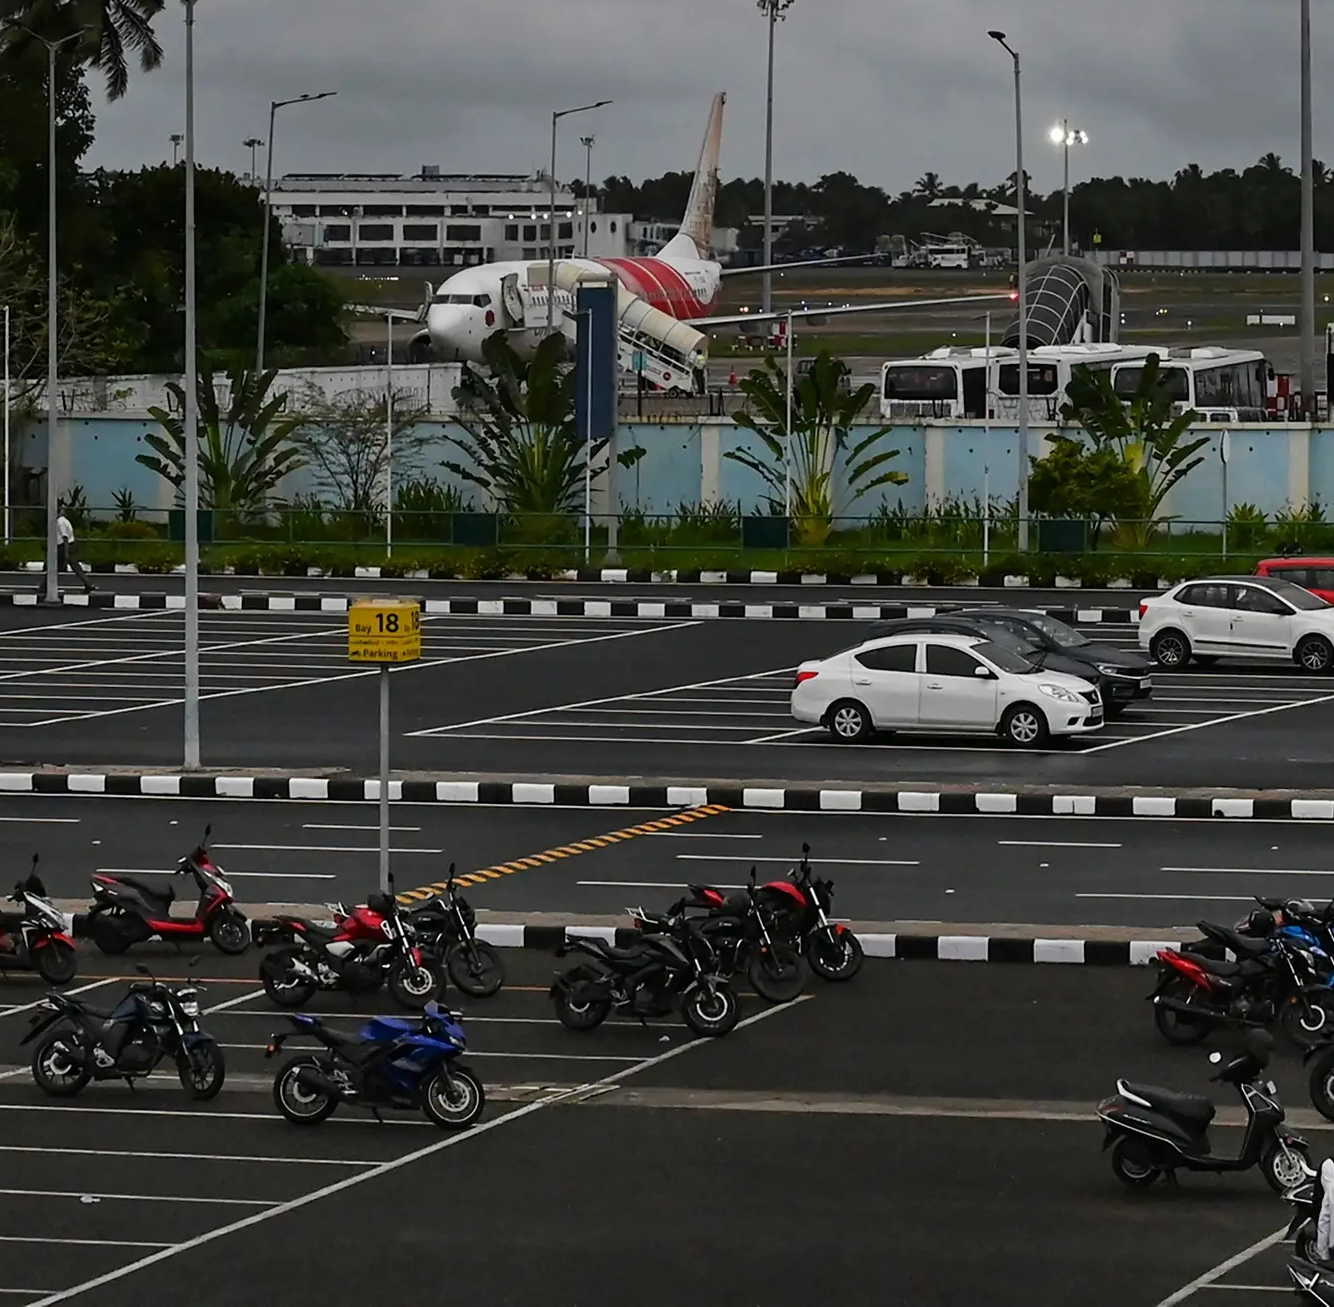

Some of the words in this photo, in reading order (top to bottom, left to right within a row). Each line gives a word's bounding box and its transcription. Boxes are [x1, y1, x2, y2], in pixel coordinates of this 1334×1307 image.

[354, 623, 372, 634] Bay
[375, 613, 400, 633] 18
[362, 649, 398, 660] Parking
